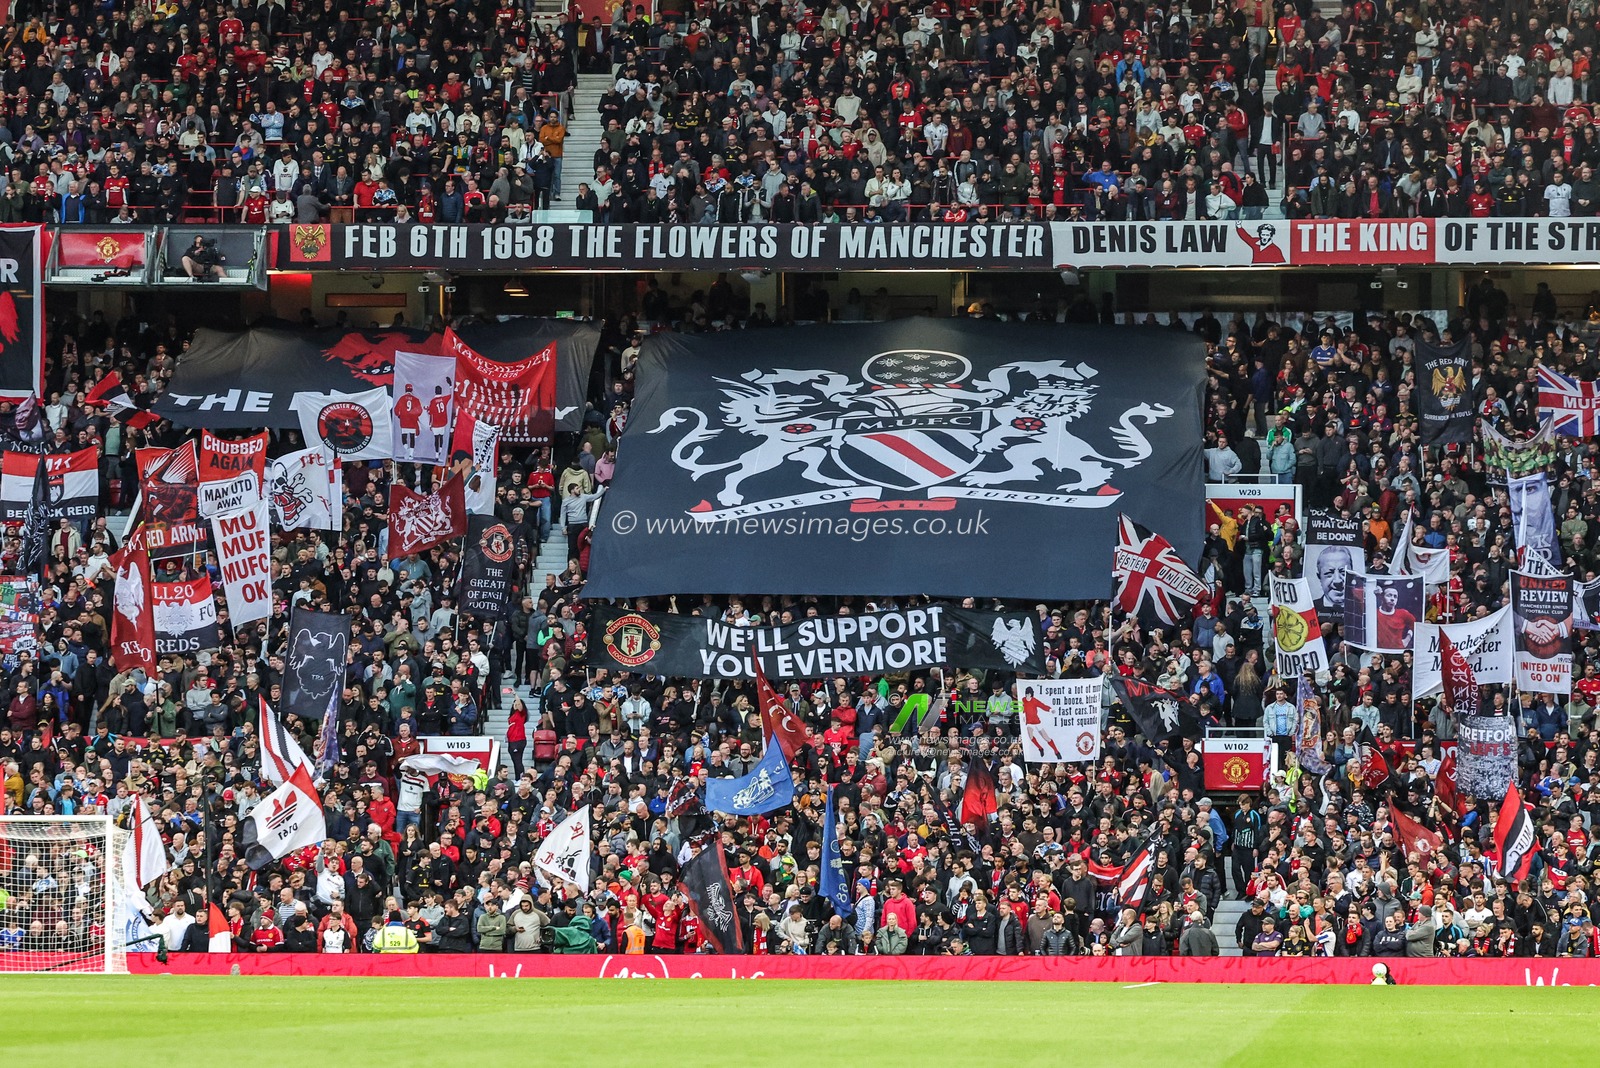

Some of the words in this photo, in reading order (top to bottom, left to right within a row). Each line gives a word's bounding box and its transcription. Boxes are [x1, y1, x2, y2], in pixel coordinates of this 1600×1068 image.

[345, 225, 397, 259] FEB
[409, 225, 468, 259] 6TH
[481, 225, 555, 260] 1958
[569, 225, 623, 259] THE
[635, 225, 777, 259] FLOWERS
[790, 226, 826, 259] OF
[839, 225, 1044, 259] MANCHESTER
[1072, 224, 1157, 254] DENIS
[1165, 224, 1228, 253] LAW
[1298, 222, 1351, 252] THE
[1359, 221, 1428, 252] KING
[1445, 222, 1478, 251] OF
[1487, 222, 1539, 251] THE
[1425, 360, 1439, 370] THE
[168, 388, 274, 413] THE
[203, 435, 264, 455] CHUBBED
[210, 454, 255, 470] AGAIN
[204, 486, 229, 501] MAN
[231, 479, 252, 494] UTD
[966, 490, 1079, 504] EUROPE
[67, 505, 96, 516] REDS
[216, 496, 243, 511] AWAY
[715, 498, 805, 521] PRIDE
[819, 489, 854, 501] OF
[220, 511, 257, 537] MU
[1311, 520, 1336, 529] WHAT
[146, 529, 164, 549] RED
[171, 524, 205, 545] ARMY
[1316, 532, 1328, 540] BE
[222, 530, 265, 559] MUF
[223, 553, 269, 585] MUFC
[486, 567, 503, 577] THE
[1158, 568, 1201, 595] UNITED
[1519, 576, 1567, 590] UNITED
[242, 580, 269, 603] OK
[467, 591, 481, 599] OF
[1519, 590, 1569, 603] REVIEW
[199, 603, 214, 621] FC
[609, 617, 642, 633] MANCHESTER
[642, 621, 657, 639] UNITED
[706, 618, 789, 653] WE'LL
[798, 606, 944, 644] SUPPORT
[156, 637, 200, 653] REDS
[612, 650, 636, 664] FOOTBALL
[636, 654, 649, 663] CLUB
[700, 649, 766, 677] YOU
[777, 636, 947, 676] EVERMORE
[1549, 663, 1570, 673] WILL
[1531, 673, 1543, 682] GO
[1545, 673, 1560, 683] ON
[1045, 686, 1065, 696] spent
[1068, 687, 1072, 695] a
[1086, 684, 1091, 694] of
[1052, 697, 1061, 706] on
[1058, 707, 1072, 716] fast
[1054, 717, 1058, 726] I
[1061, 717, 1075, 727] just
